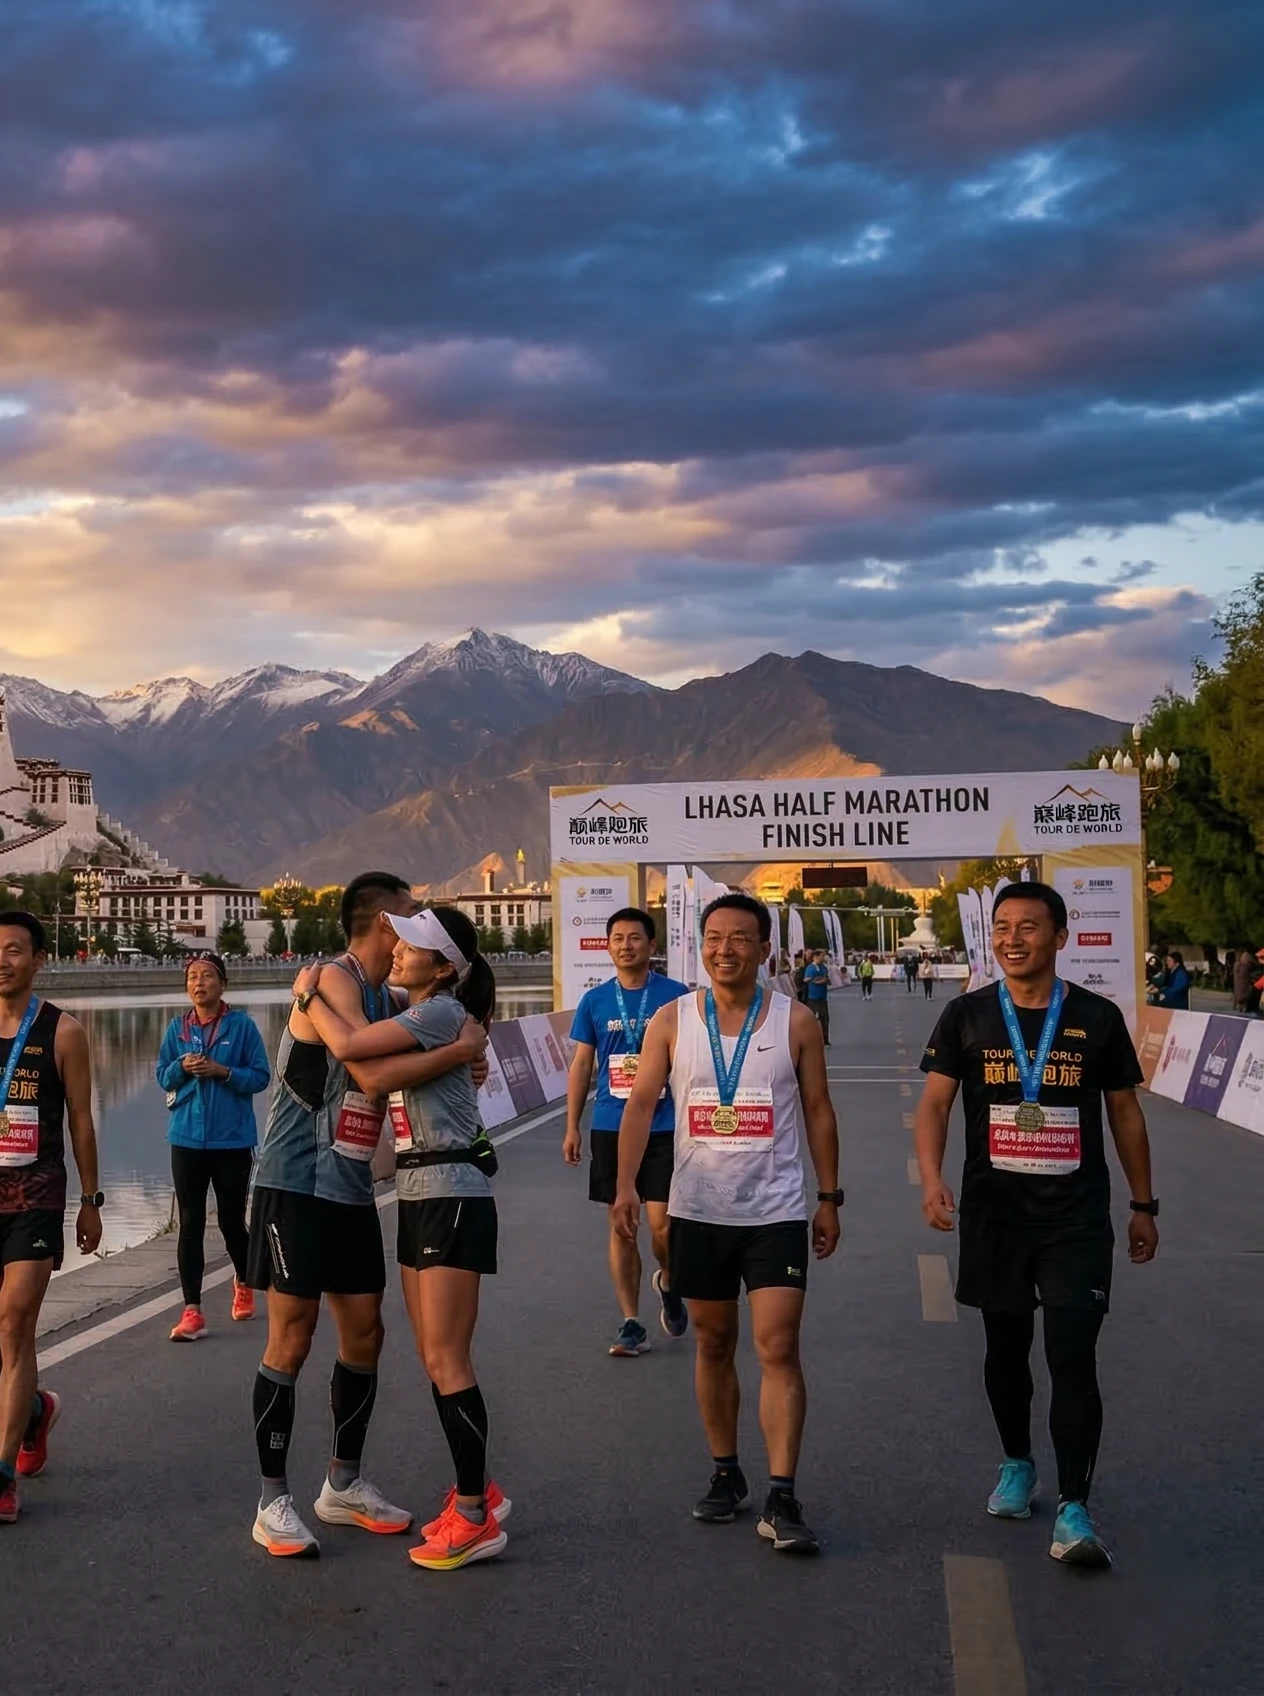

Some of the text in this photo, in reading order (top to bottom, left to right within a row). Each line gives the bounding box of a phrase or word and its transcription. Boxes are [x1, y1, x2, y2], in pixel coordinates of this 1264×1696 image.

[685, 786, 989, 819] LHASA HALF MARATHON
[1033, 803, 1121, 824] 巅峰跑旅
[762, 820, 910, 849] FINISH LINE
[1034, 823, 1123, 835] TOUR DE WORLD
[569, 835, 649, 846] TOUR DE WORLD
[982, 1049, 1014, 1060] TOUR
[1046, 1050, 1083, 1063] ORLD
